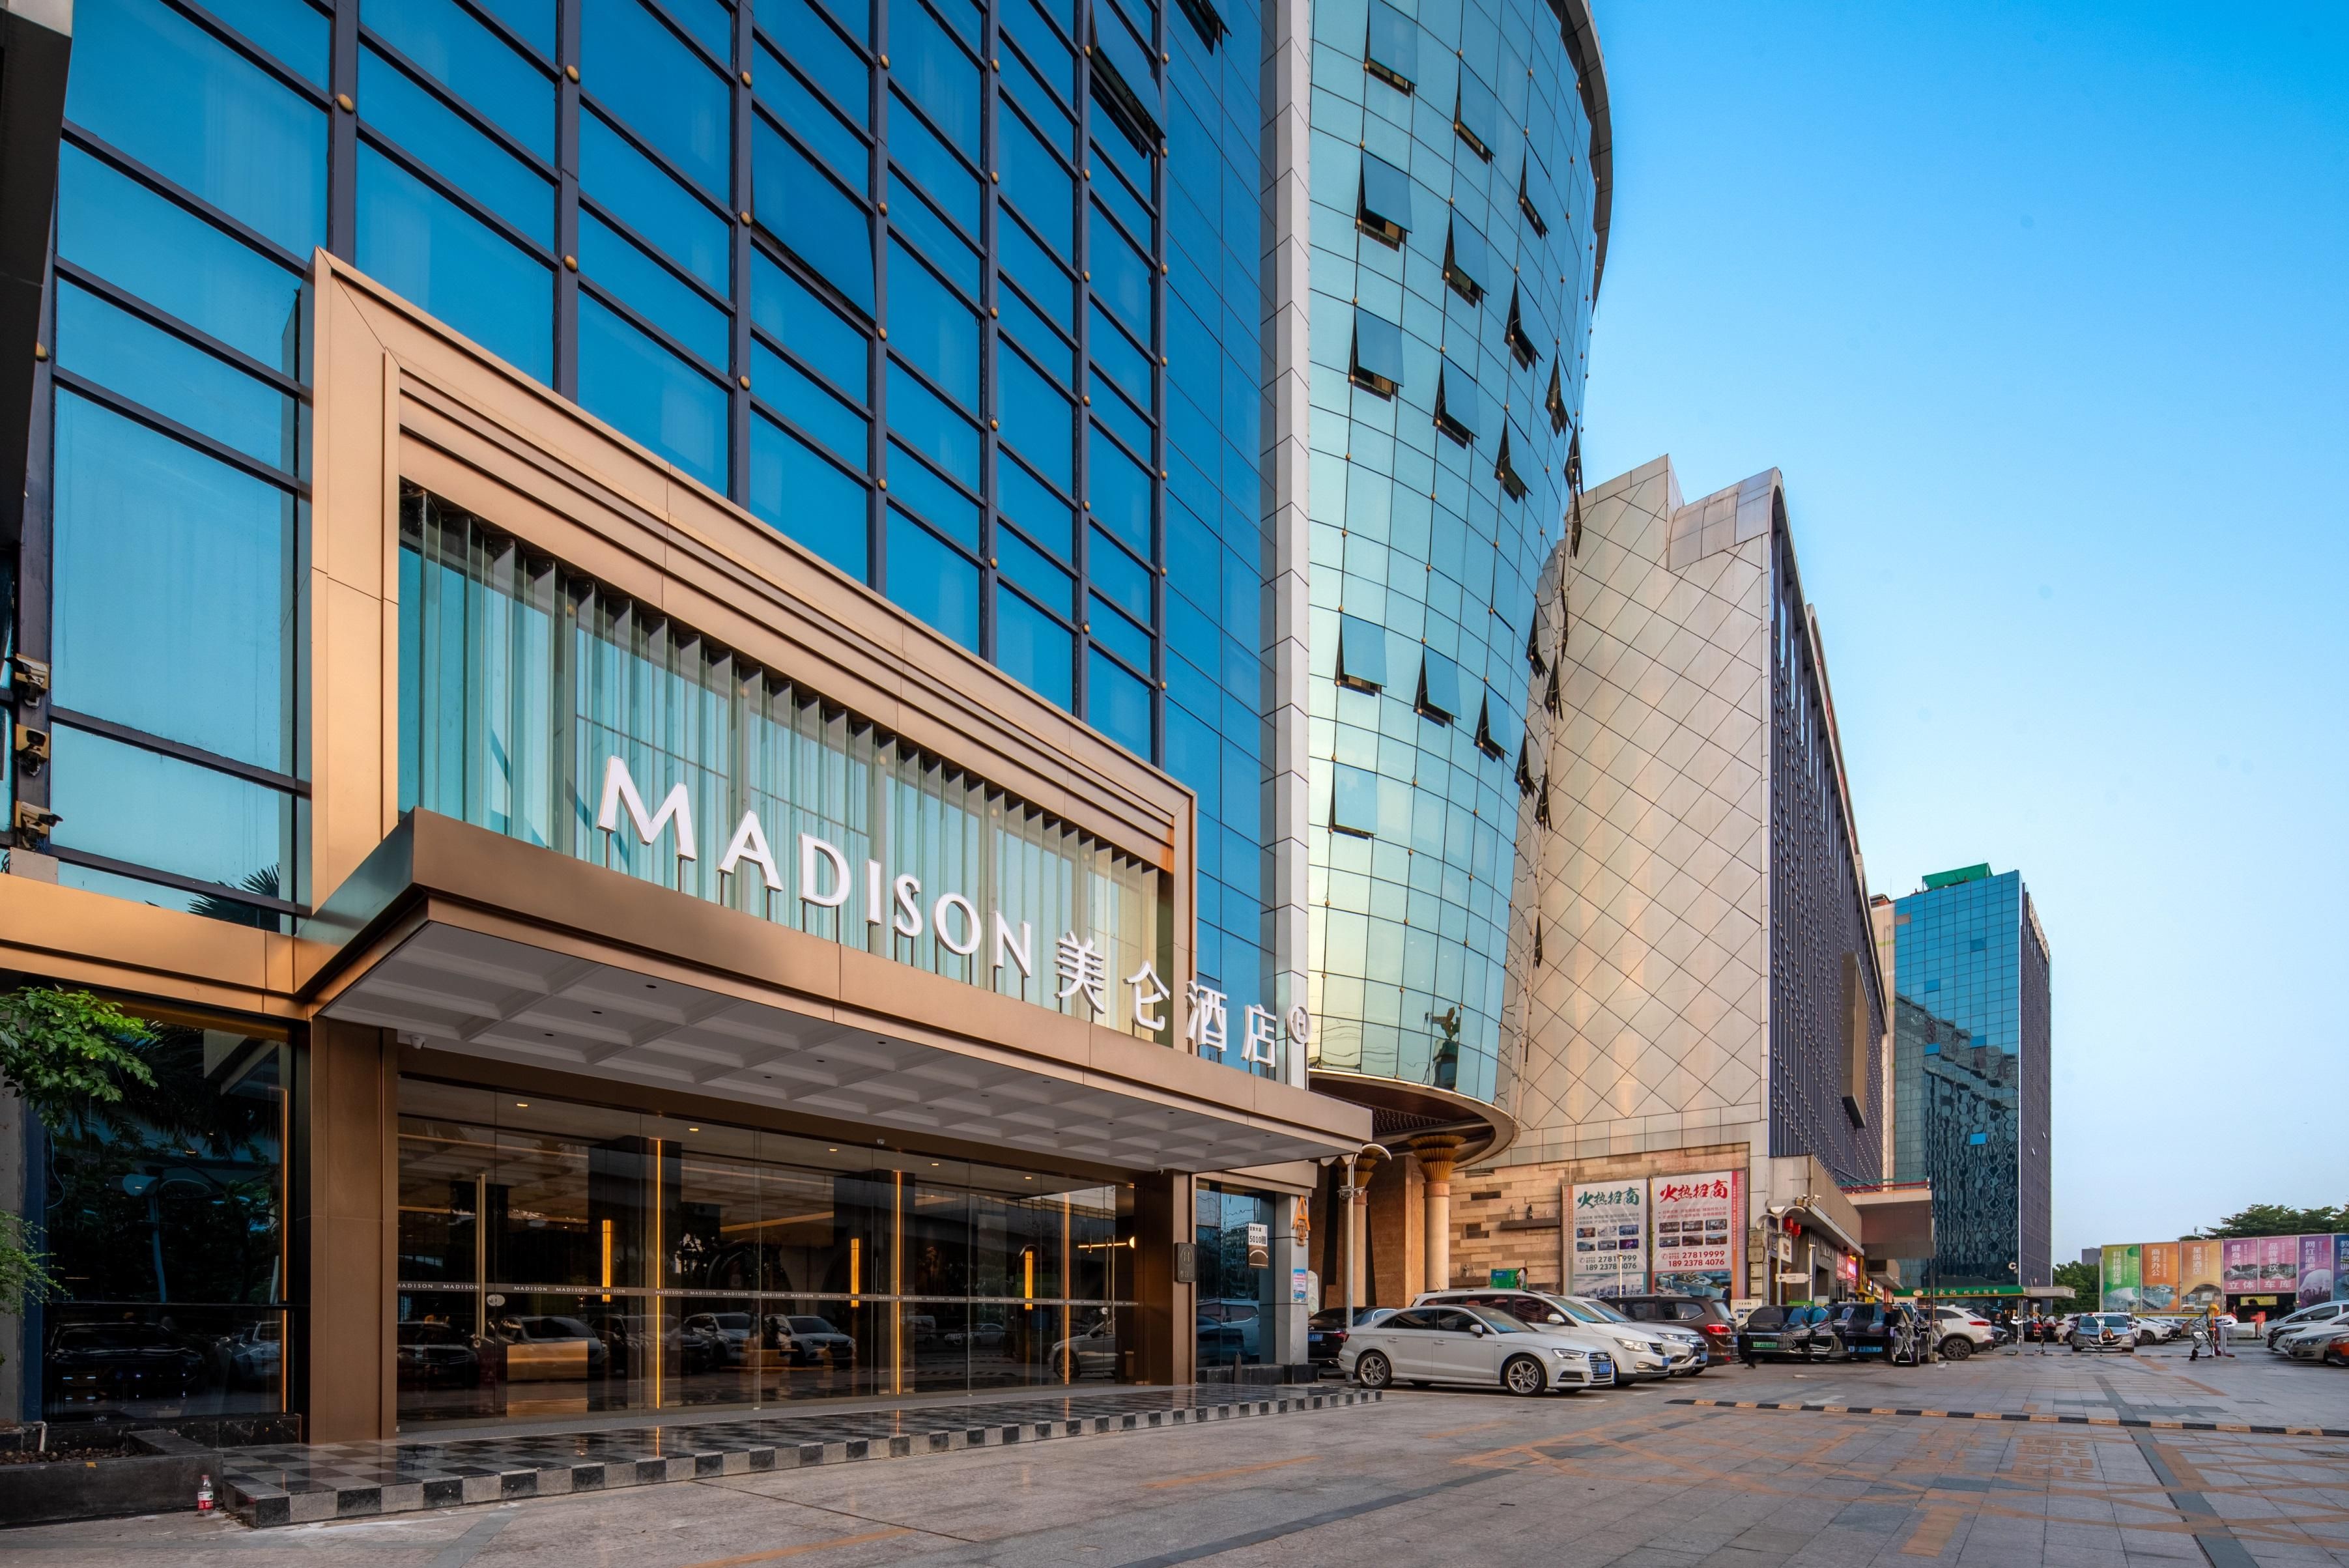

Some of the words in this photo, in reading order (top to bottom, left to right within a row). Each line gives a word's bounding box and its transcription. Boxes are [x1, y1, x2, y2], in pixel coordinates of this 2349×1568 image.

[595, 755, 1032, 978] MADISON
[1053, 930, 1277, 1068] 美仑酒店
[1577, 1187, 1640, 1210] 火热招商
[1660, 1179, 1728, 1203] 火热招商
[1249, 1235, 1262, 1244] 5010
[1682, 1250, 1725, 1259] 27819999
[2152, 1248, 2161, 1276] 商务办公
[2231, 1244, 2241, 1266] 健身房
[2305, 1241, 2315, 1271] 网红酒吧
[2228, 1280, 2292, 1290] 立体车库
